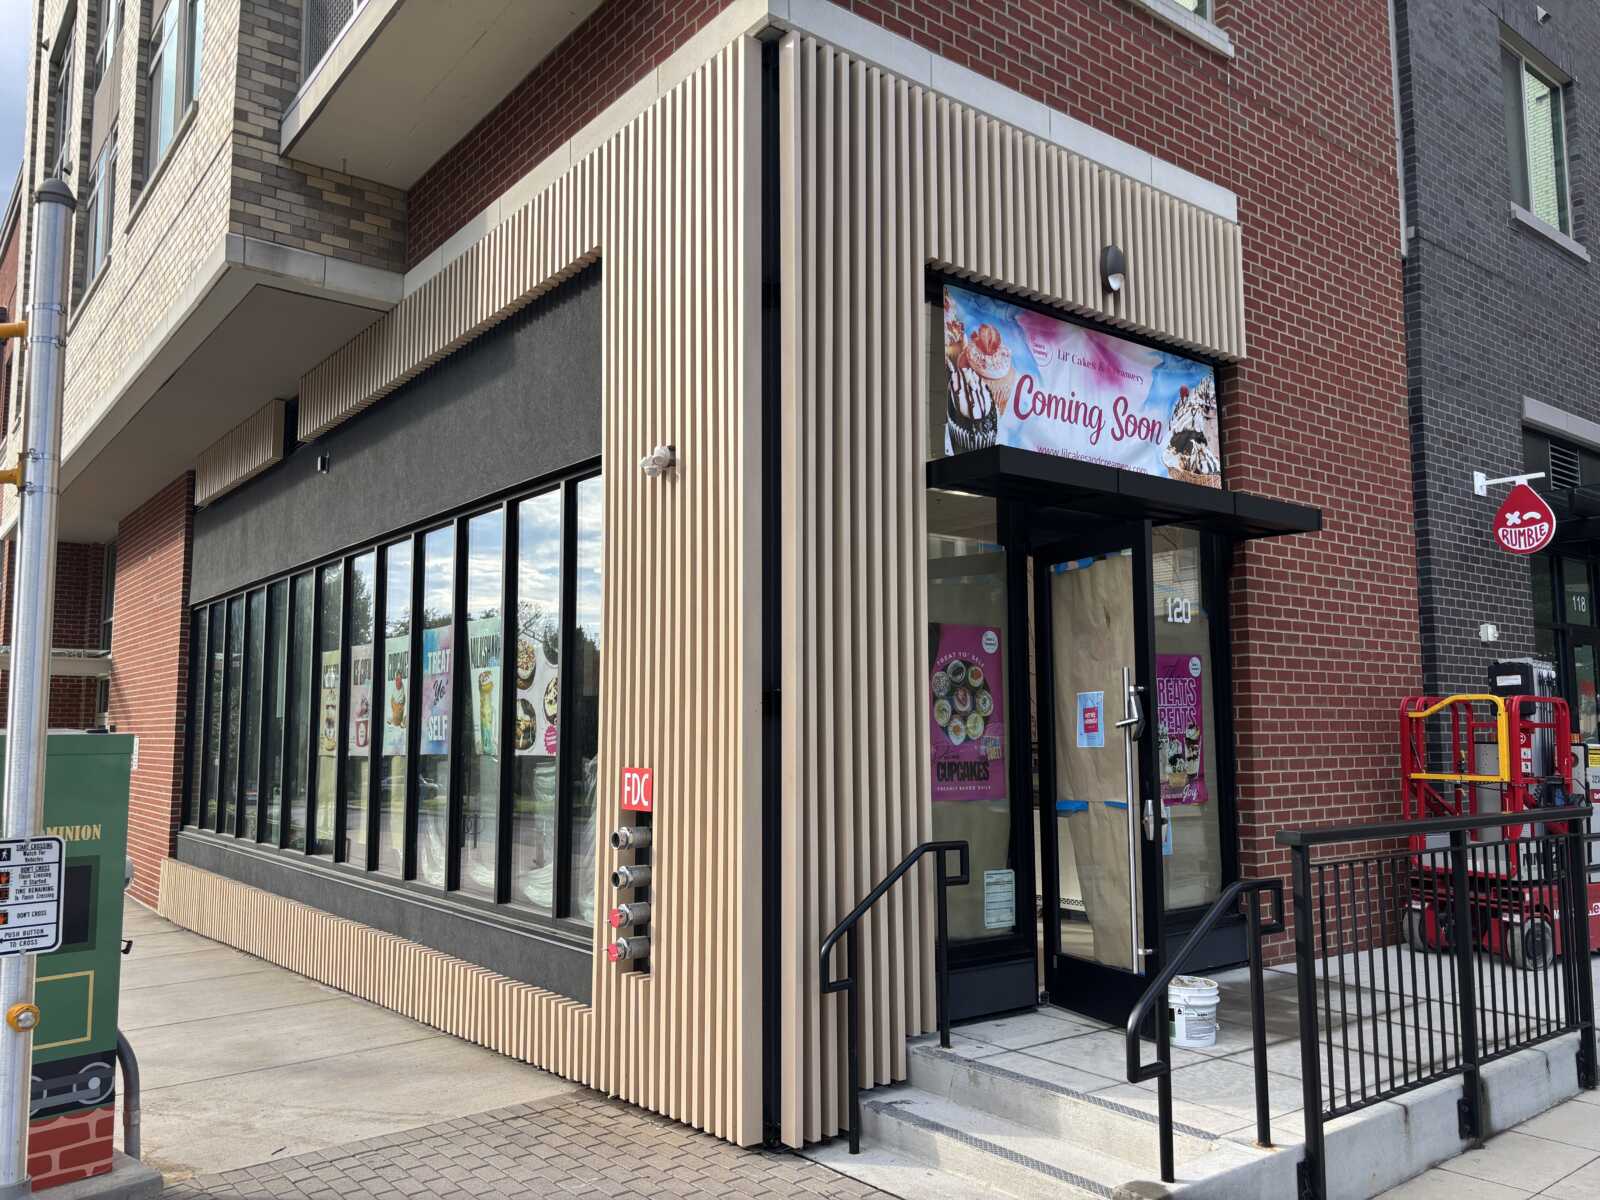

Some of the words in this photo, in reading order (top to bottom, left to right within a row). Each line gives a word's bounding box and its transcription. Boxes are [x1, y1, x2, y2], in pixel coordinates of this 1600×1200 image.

[1013, 374, 1105, 446] Coming
[1111, 395, 1163, 446] Soon
[1501, 524, 1547, 549] RUMBLE
[1167, 597, 1191, 624] 120
[1572, 595, 1586, 613] 118
[428, 648, 451, 675] TREAT
[429, 714, 448, 741] SELF
[936, 760, 990, 782] CUPCAKES
[624, 773, 649, 806] FDC
[20, 939, 38, 947] CROSS
